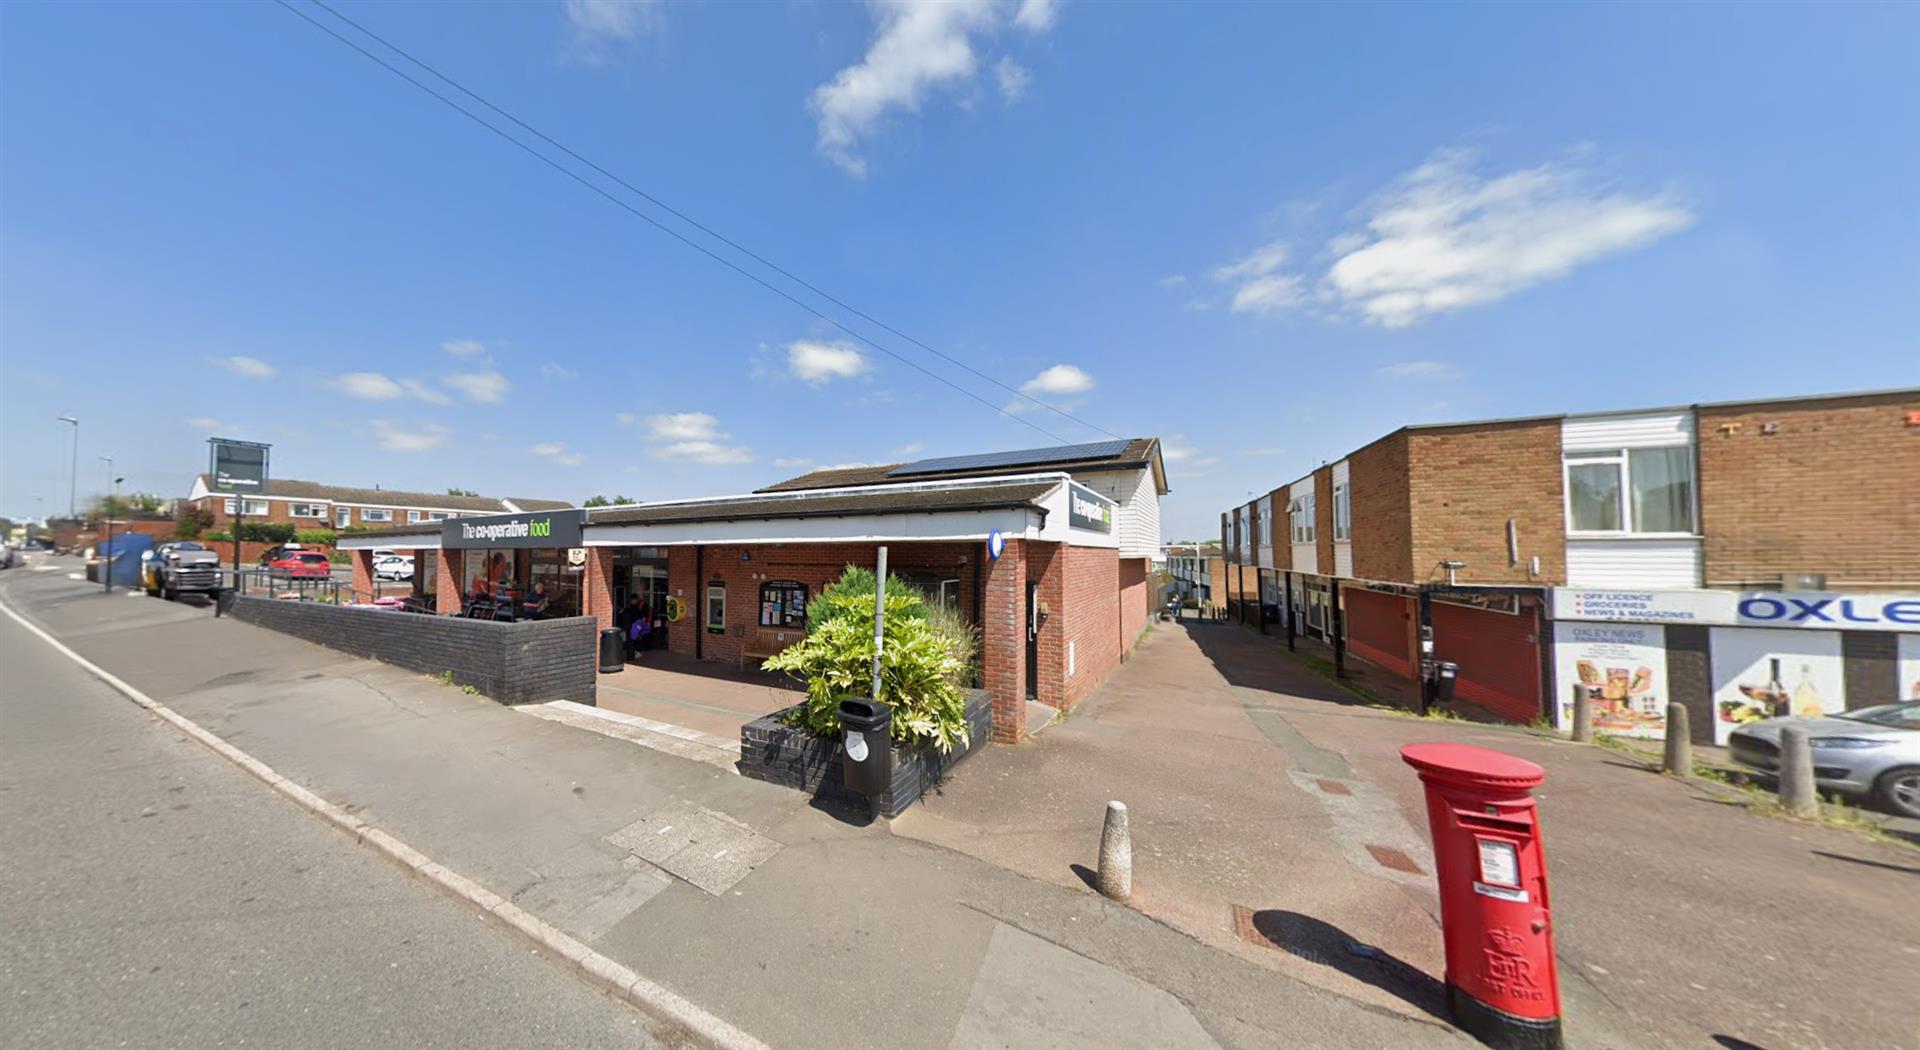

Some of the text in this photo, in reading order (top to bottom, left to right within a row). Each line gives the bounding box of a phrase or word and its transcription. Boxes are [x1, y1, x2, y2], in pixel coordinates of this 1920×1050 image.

[462, 518, 550, 541] The co-operative food
[1582, 593, 1654, 602] OFF LICENCE
[1583, 601, 1648, 609] GROCERIES
[1584, 609, 1616, 617] NEWS
[1628, 611, 1695, 619] MAGAZINES
[1573, 627, 1645, 639] OXLEY NEWS
